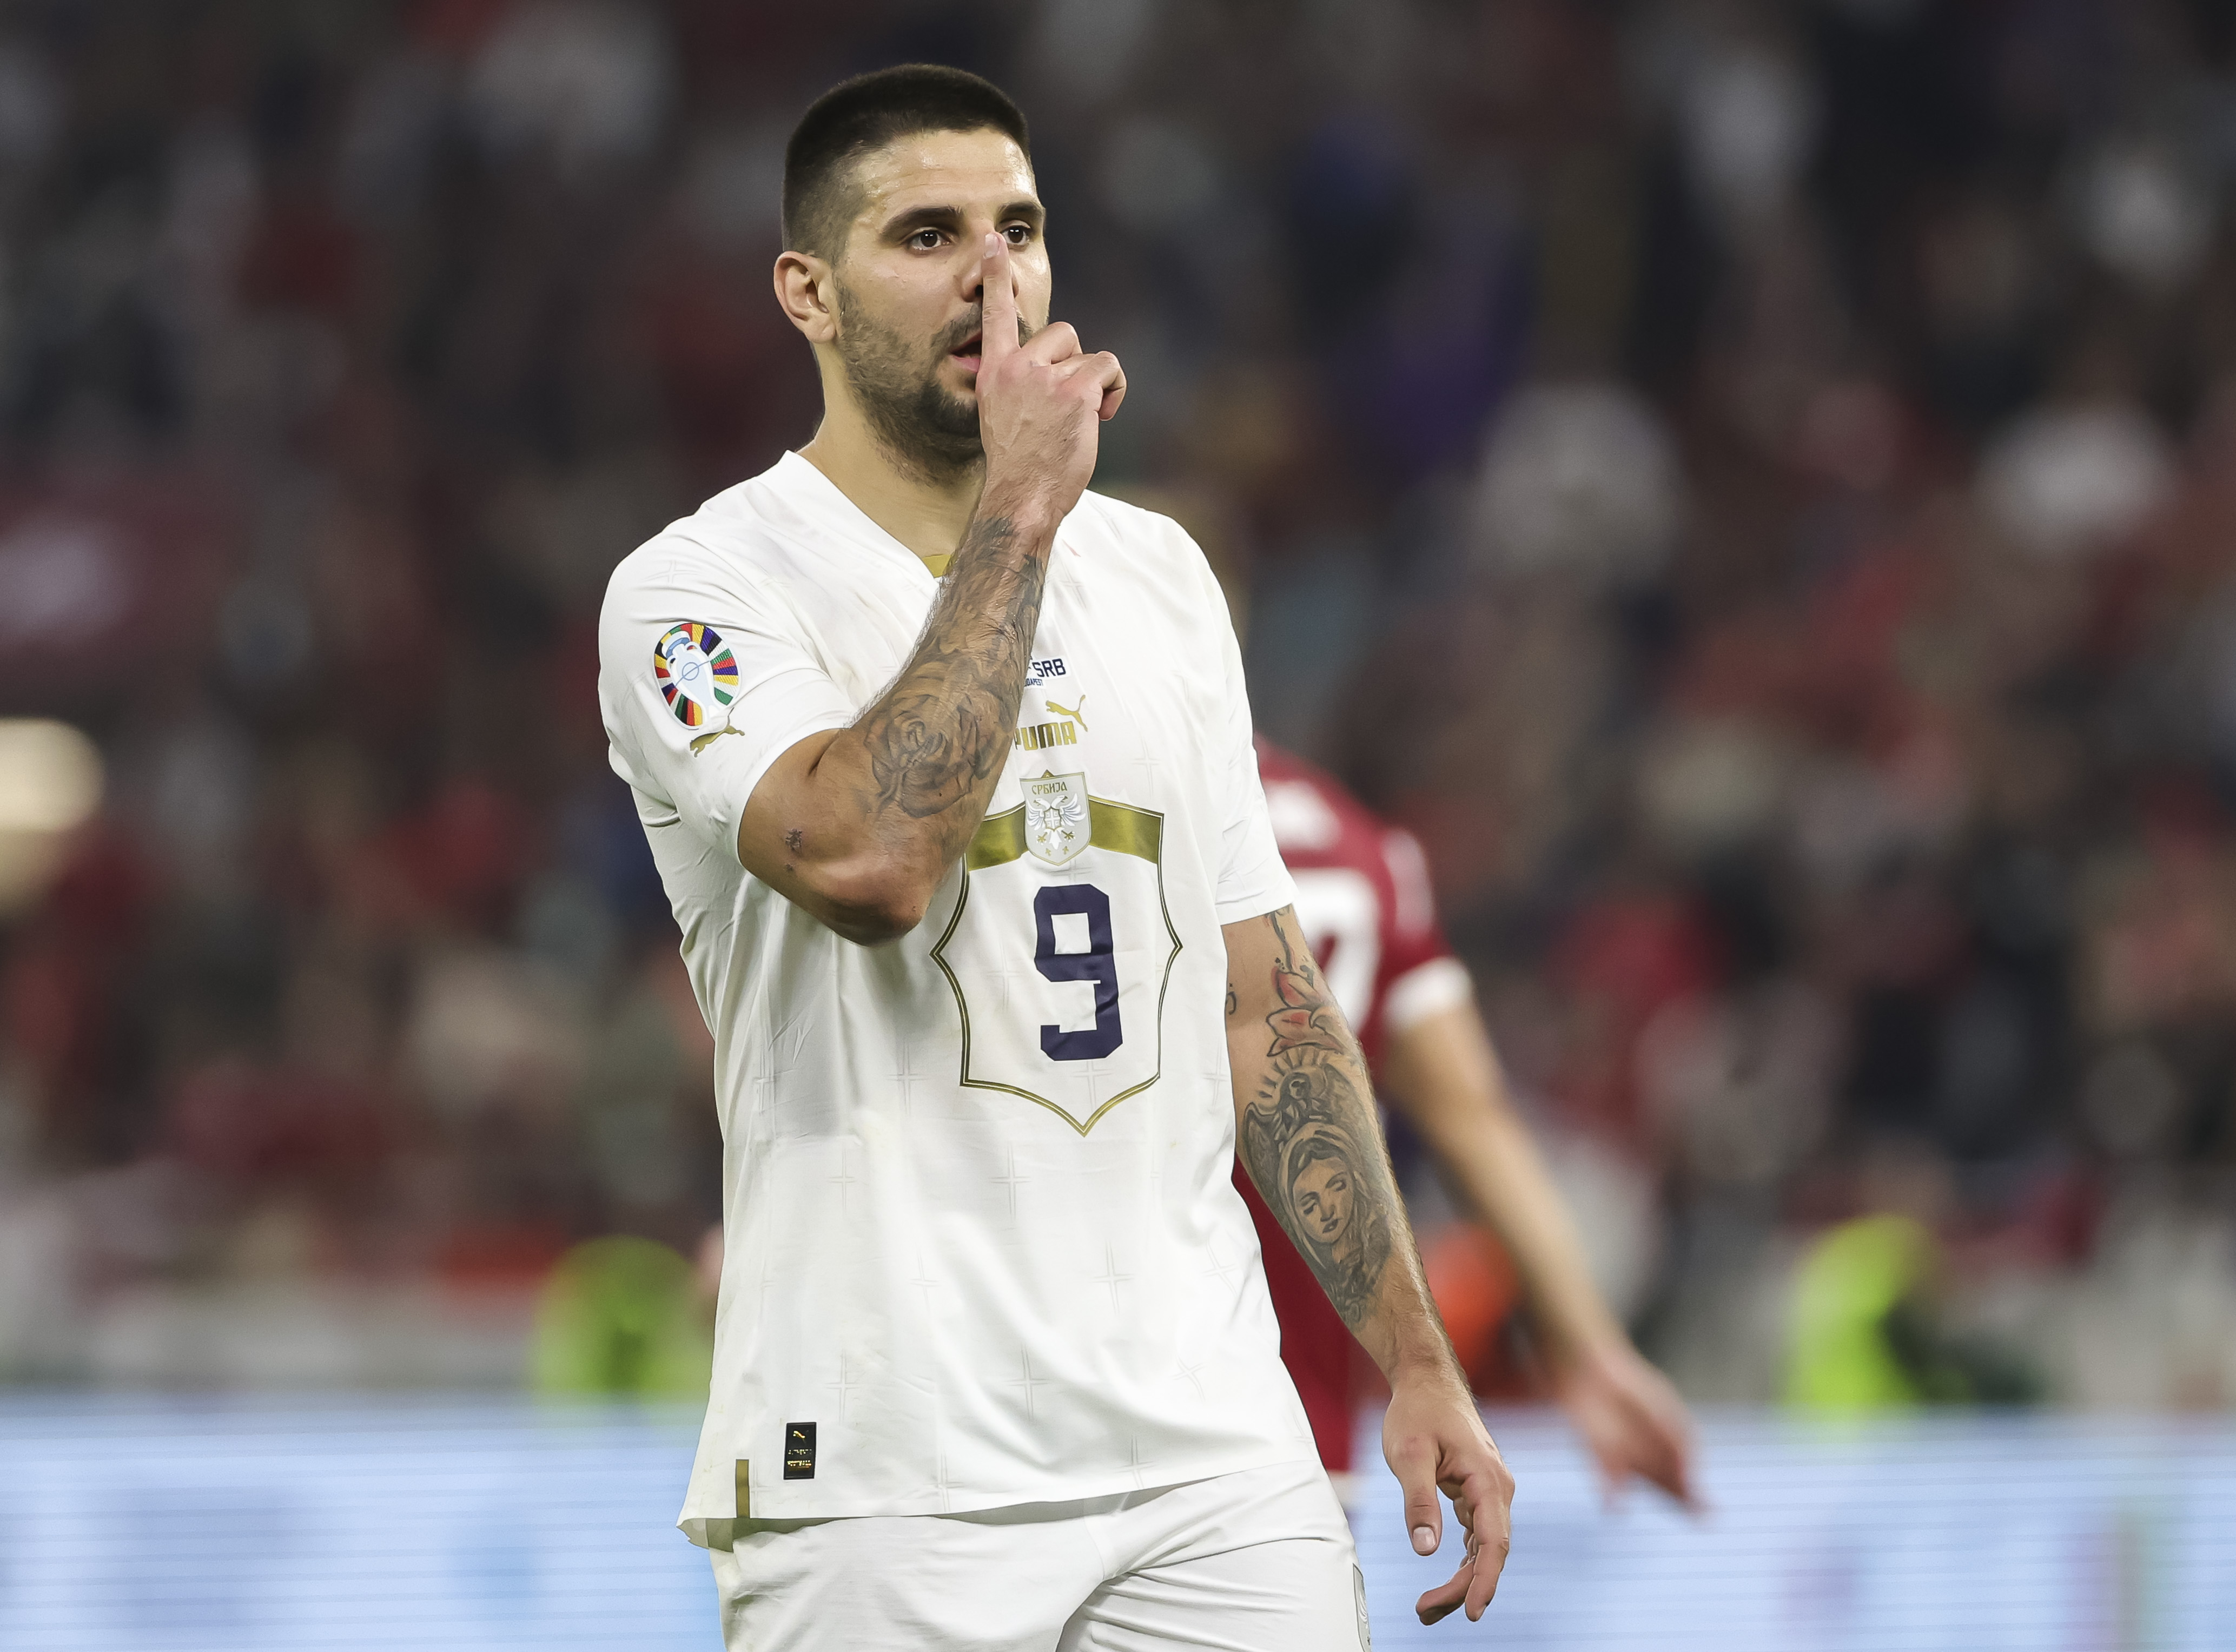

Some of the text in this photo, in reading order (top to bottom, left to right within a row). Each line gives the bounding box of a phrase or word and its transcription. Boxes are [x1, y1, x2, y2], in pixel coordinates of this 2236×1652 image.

[1031, 658, 1066, 677] SRB
[1031, 781, 1068, 795] СРБИЈА
[1034, 883, 1123, 1061] 9
